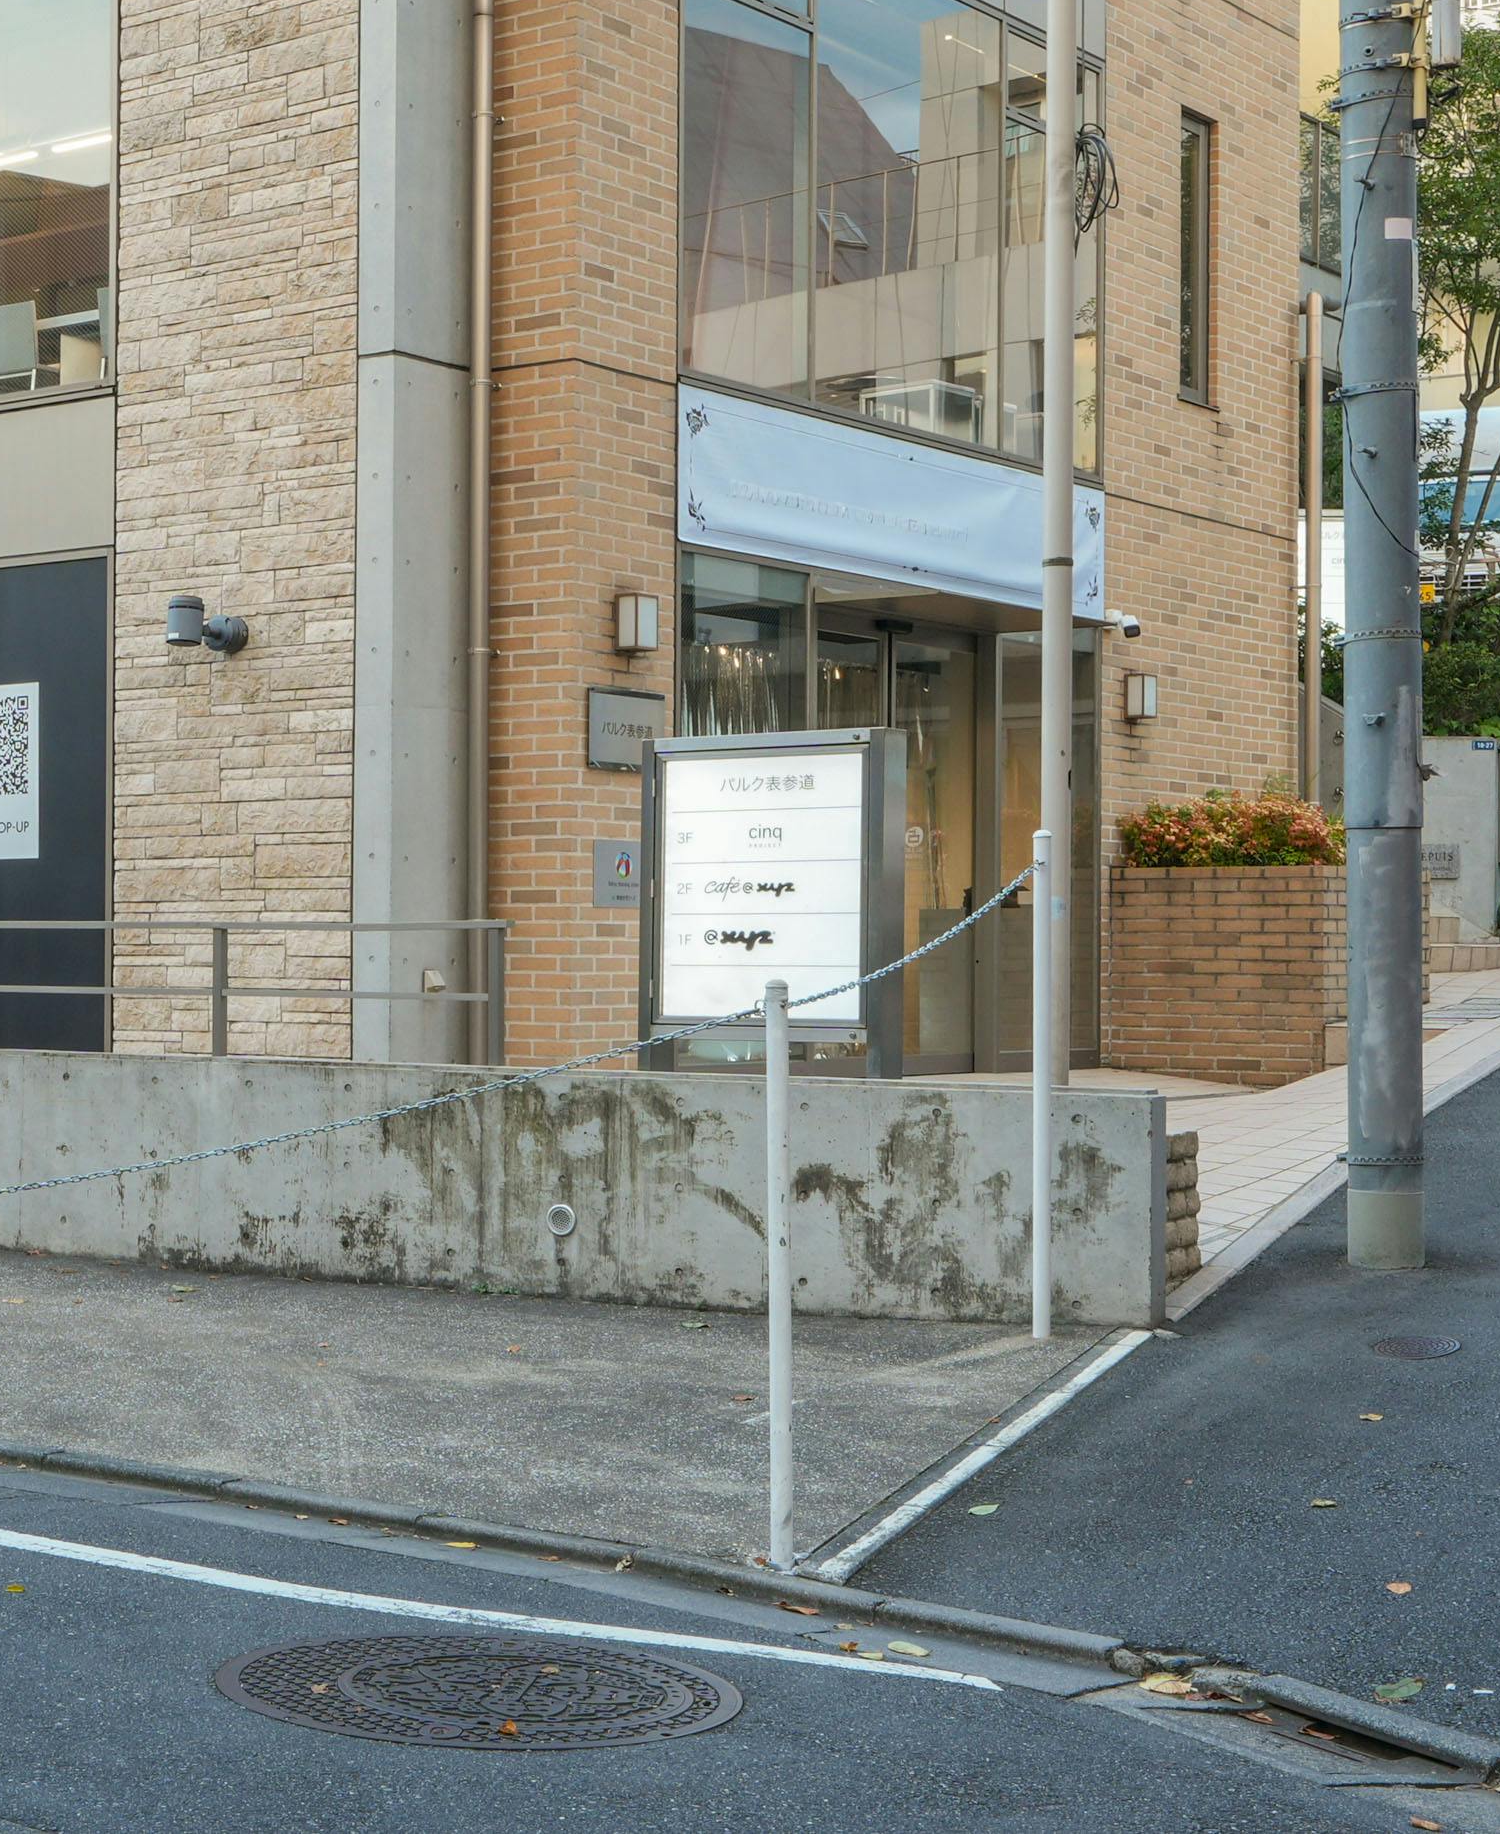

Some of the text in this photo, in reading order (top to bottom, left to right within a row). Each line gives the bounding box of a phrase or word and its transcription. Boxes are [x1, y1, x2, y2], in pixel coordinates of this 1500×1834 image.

[677, 824, 782, 844] 3F cinq
[1421, 852, 1454, 862] EPUIS
[677, 882, 693, 895] 2F
[678, 933, 692, 946] 1F
